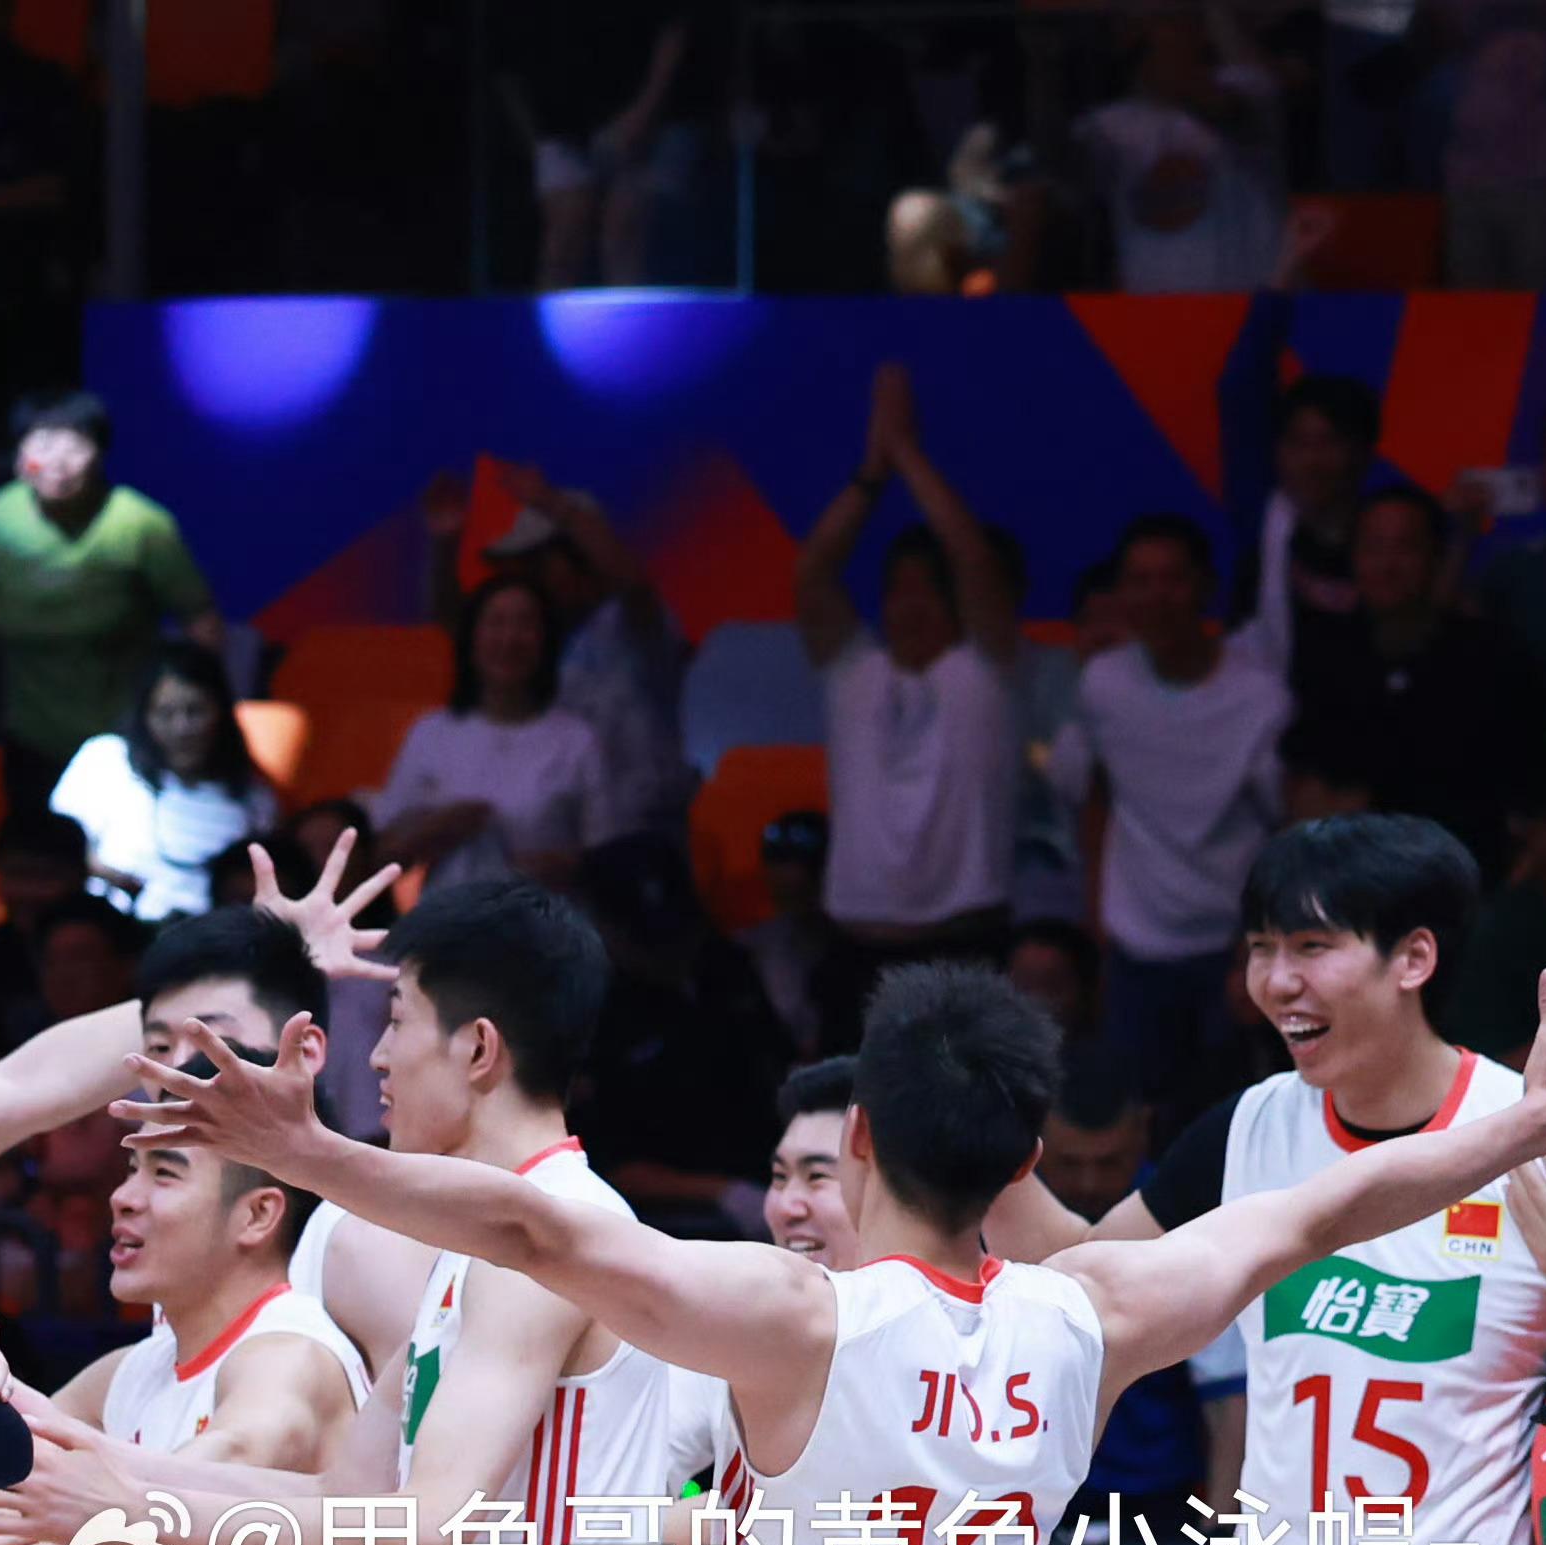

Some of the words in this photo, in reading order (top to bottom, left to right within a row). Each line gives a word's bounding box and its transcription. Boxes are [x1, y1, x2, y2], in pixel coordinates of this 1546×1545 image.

[1447, 1239, 1492, 1255] CHN
[1300, 1275, 1431, 1343] 怡寶
[1292, 1374, 1430, 1517] 15
